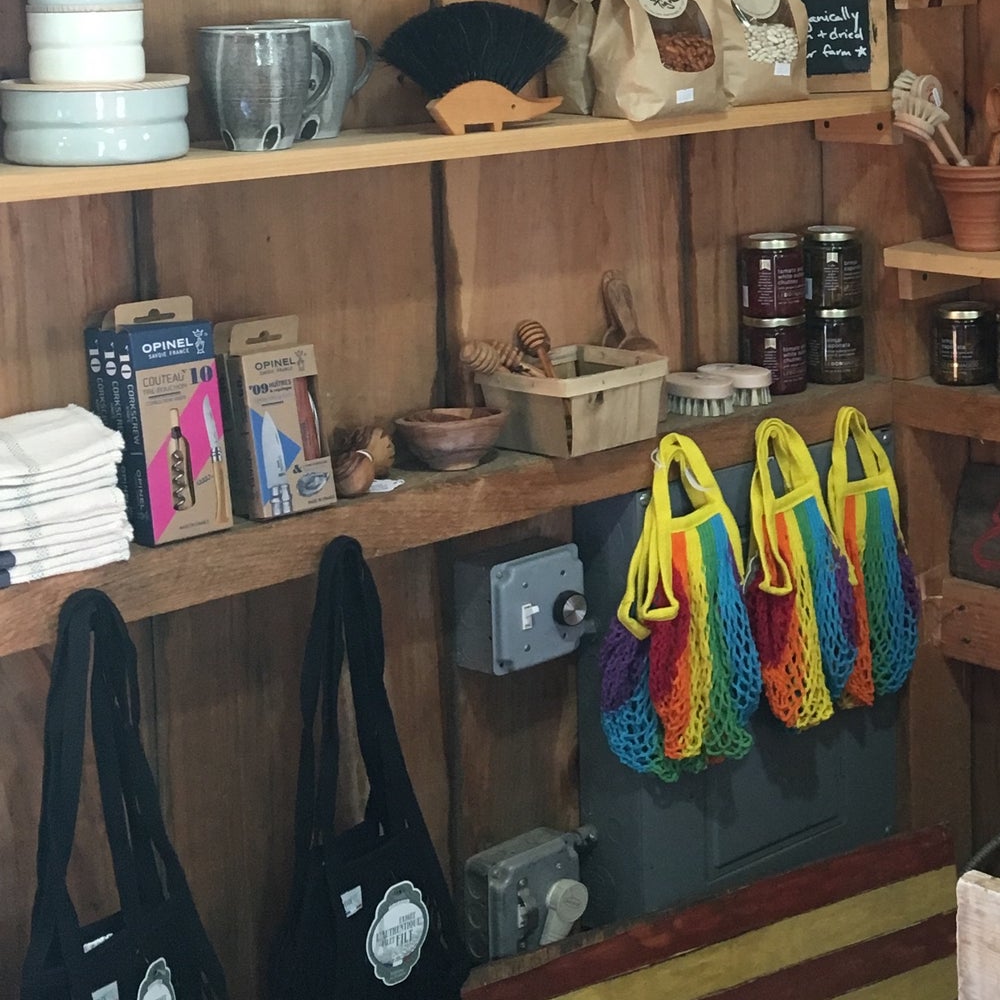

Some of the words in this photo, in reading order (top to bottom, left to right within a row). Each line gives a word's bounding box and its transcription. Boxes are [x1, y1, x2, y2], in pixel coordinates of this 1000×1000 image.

[829, 27, 864, 41] dried
[823, 44, 852, 58] farm
[141, 337, 193, 354] OPINEL
[254, 358, 296, 371] OPINEL
[143, 374, 185, 388] COUTEAU
[190, 365, 213, 385] 10
[127, 384, 140, 445] CORKSCREW
[293, 464, 303, 475] &
